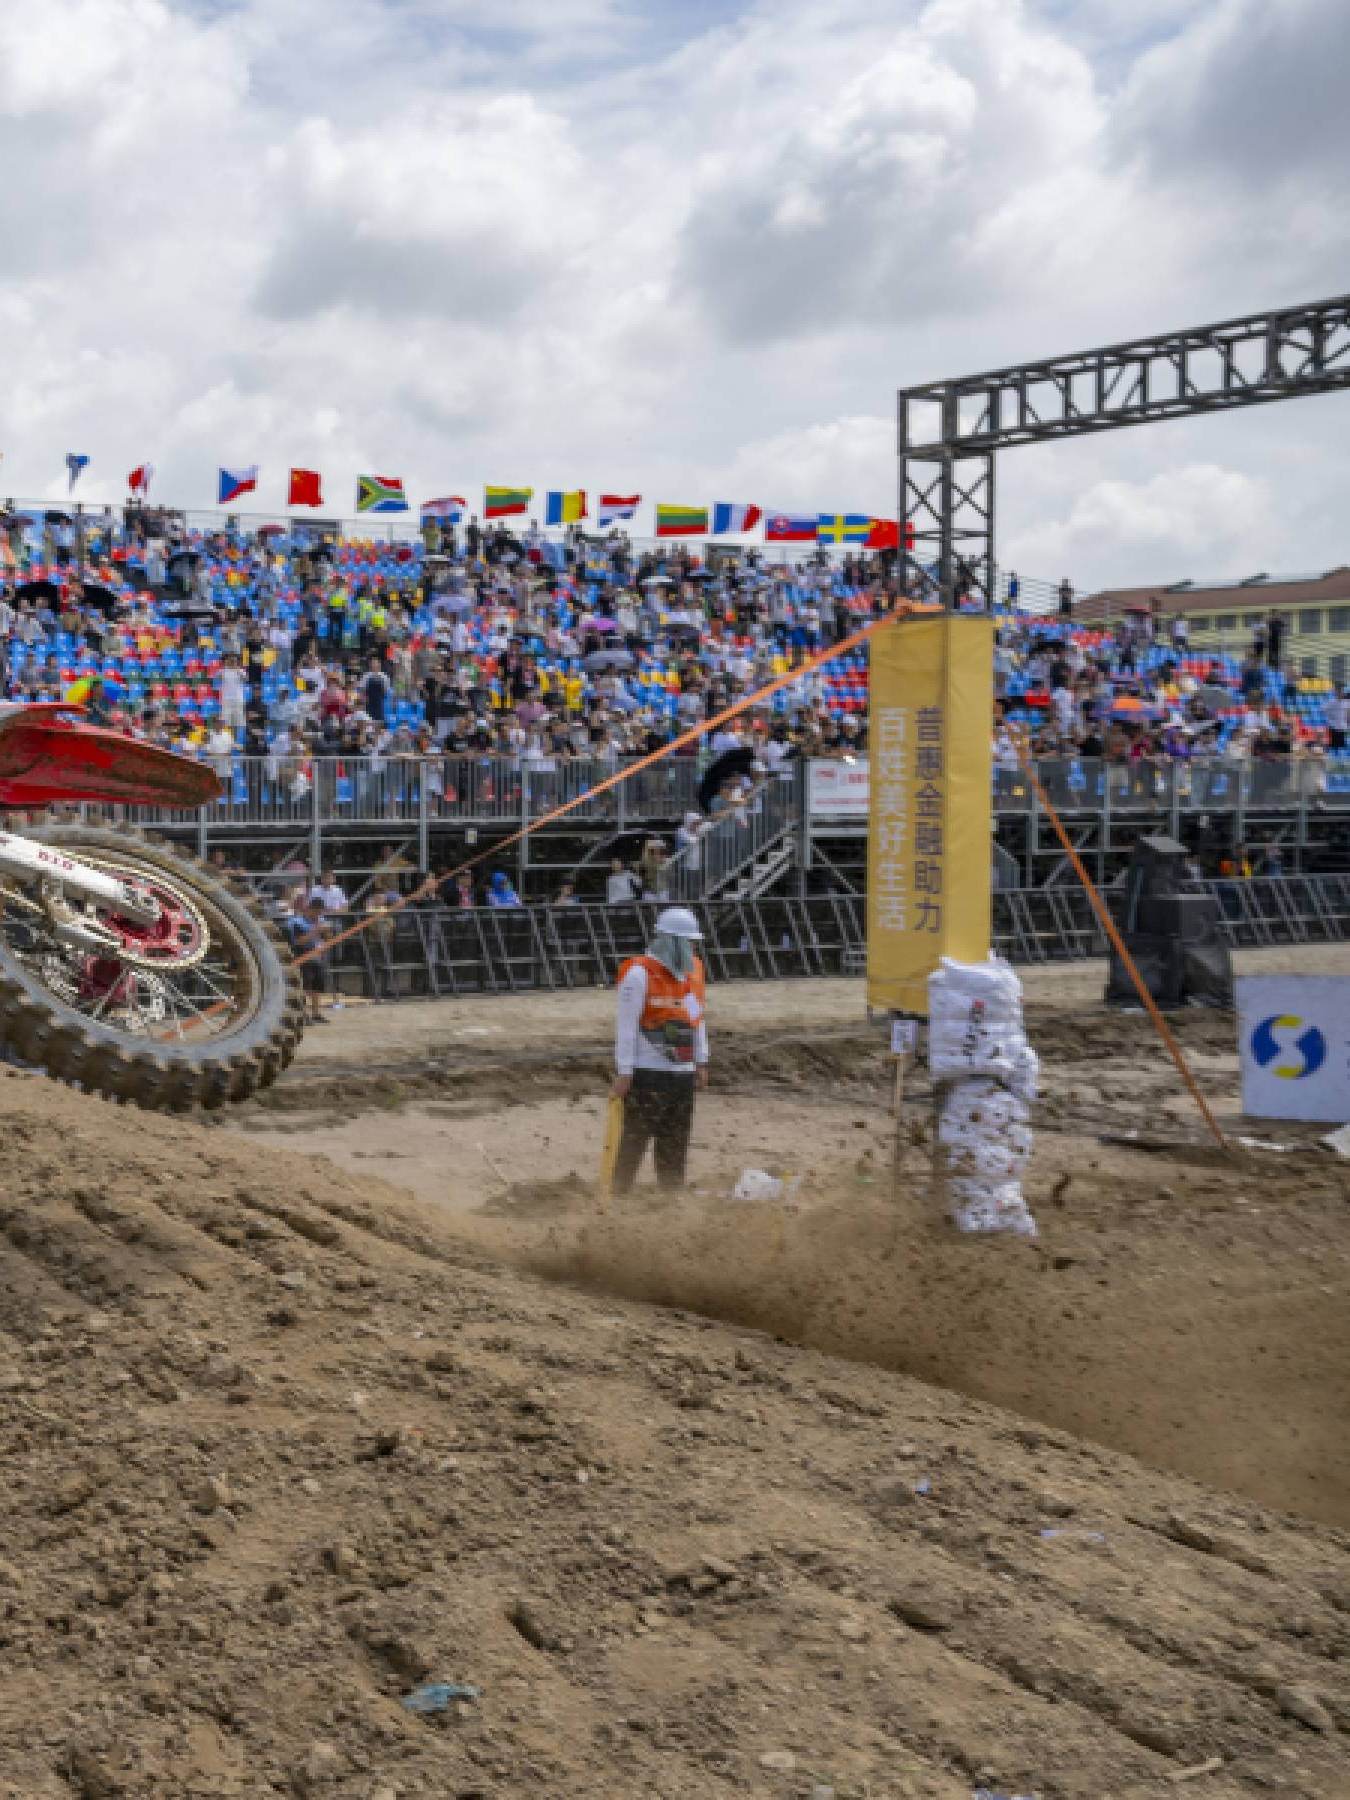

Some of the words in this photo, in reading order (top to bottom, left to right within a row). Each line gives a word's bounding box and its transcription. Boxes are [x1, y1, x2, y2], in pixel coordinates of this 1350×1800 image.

[875, 707, 907, 932] 百姓美好生活
[914, 705, 944, 934] 普惠金融助力
